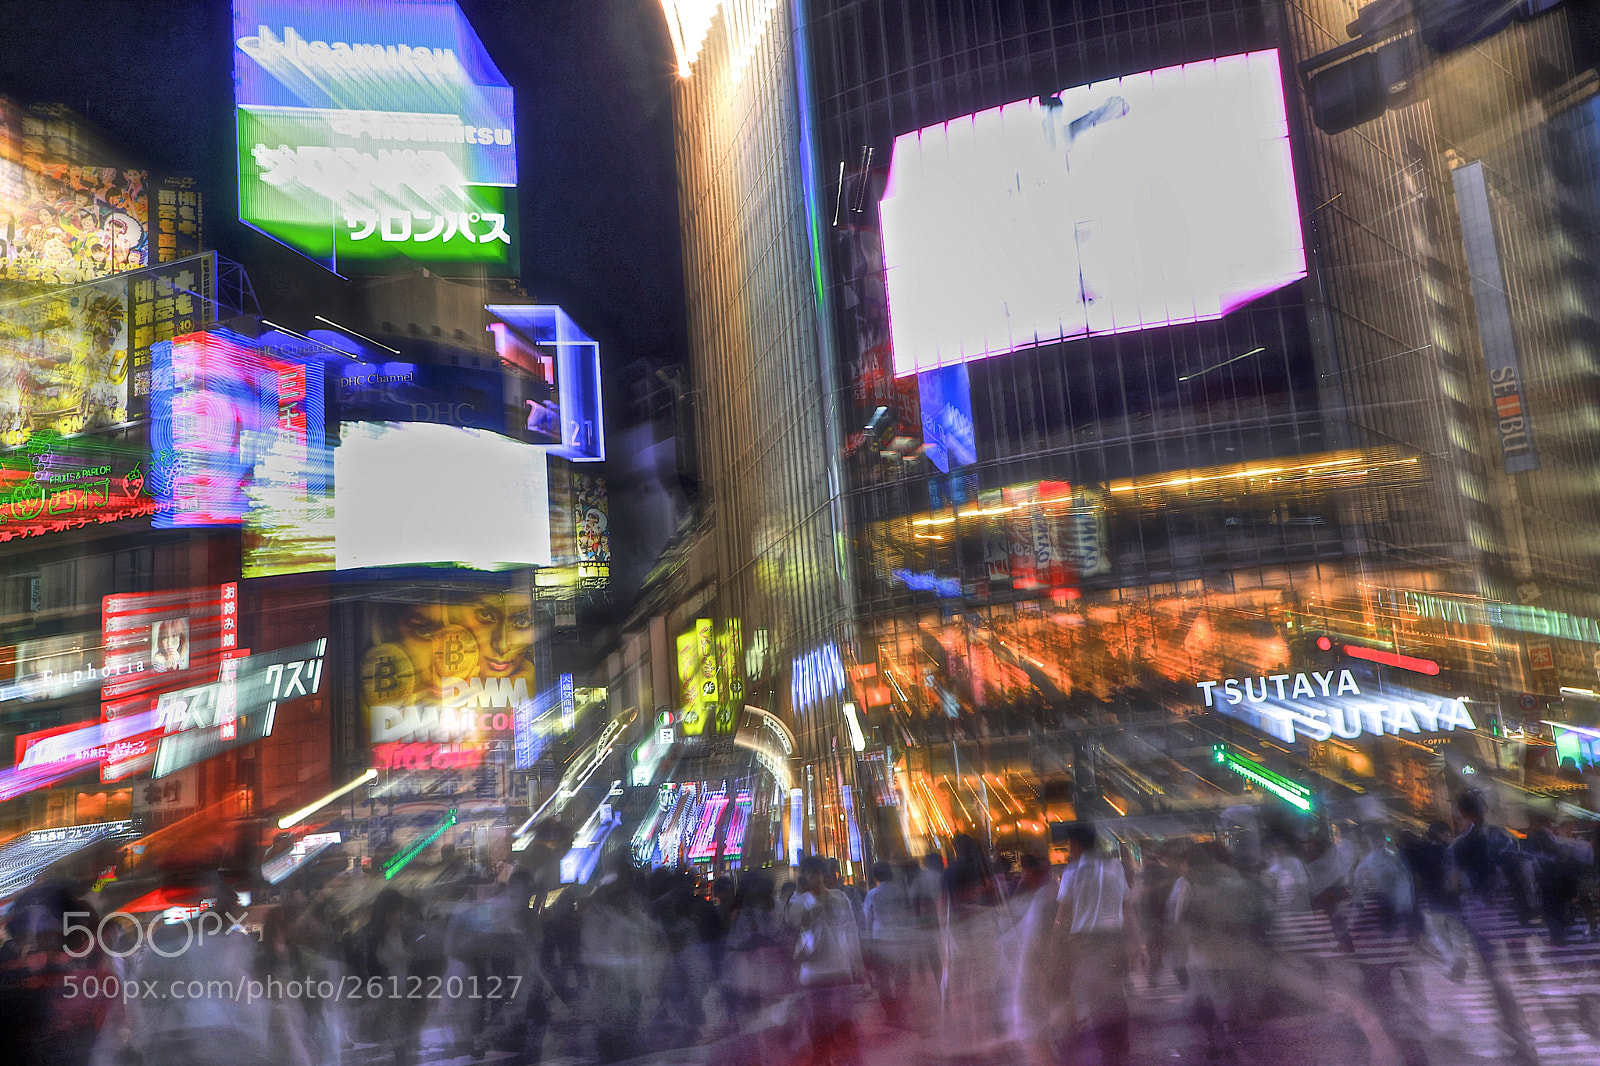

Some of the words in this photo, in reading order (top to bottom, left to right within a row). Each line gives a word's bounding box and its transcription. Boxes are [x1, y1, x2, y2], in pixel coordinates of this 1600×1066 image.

[343, 208, 511, 245] サロンパス
[340, 375, 365, 387] DHC
[367, 371, 414, 384] Channel
[410, 402, 475, 425] DHC
[1490, 366, 1528, 452] SEIBU
[49, 477, 110, 515] 西村
[43, 660, 145, 687] Euphoria
[265, 658, 324, 700] クスリ
[442, 676, 531, 708] DMM
[1197, 669, 1361, 707] TSUTAYA
[1270, 698, 1477, 744] TSUTAYA
